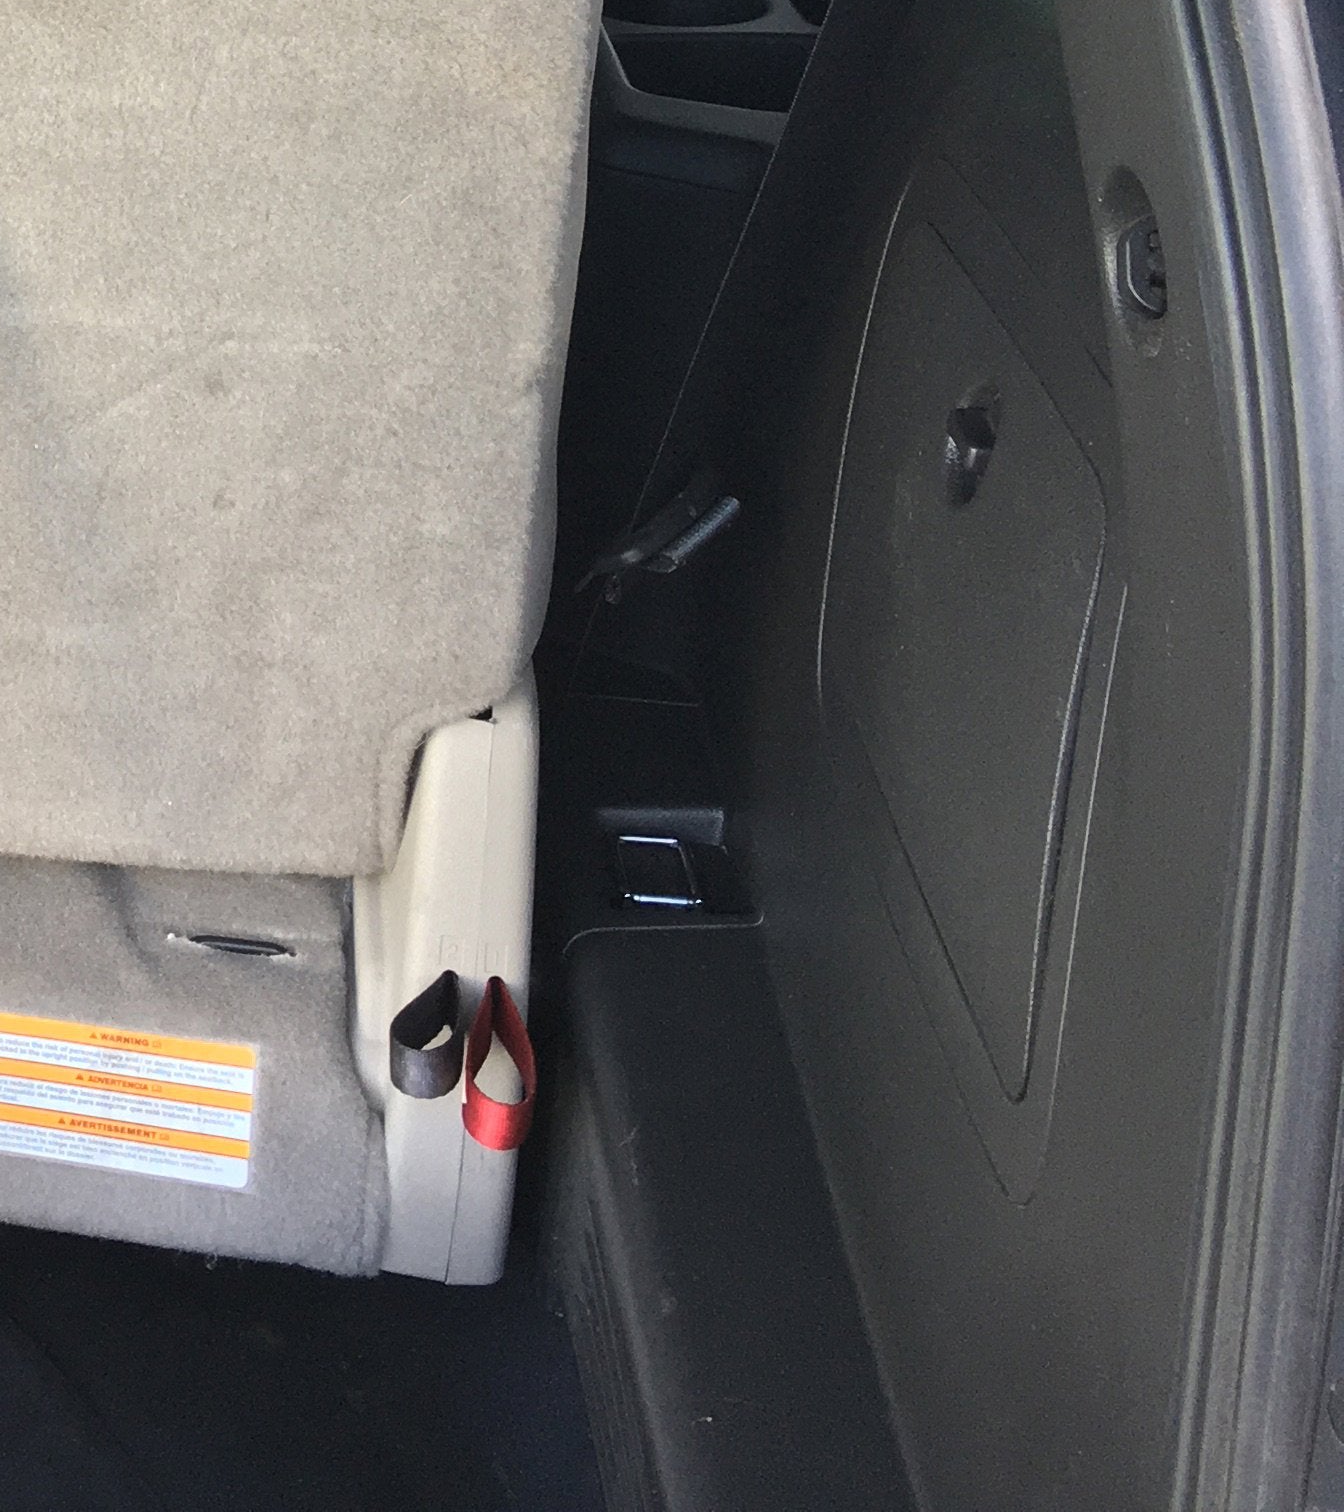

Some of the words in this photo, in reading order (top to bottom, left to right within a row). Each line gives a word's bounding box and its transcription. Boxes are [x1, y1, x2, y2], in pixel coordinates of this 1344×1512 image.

[99, 1033, 149, 1047] WARNING
[87, 1075, 148, 1090] ADVERTENCIA
[69, 1118, 156, 1139] AVERTISSEMENT
